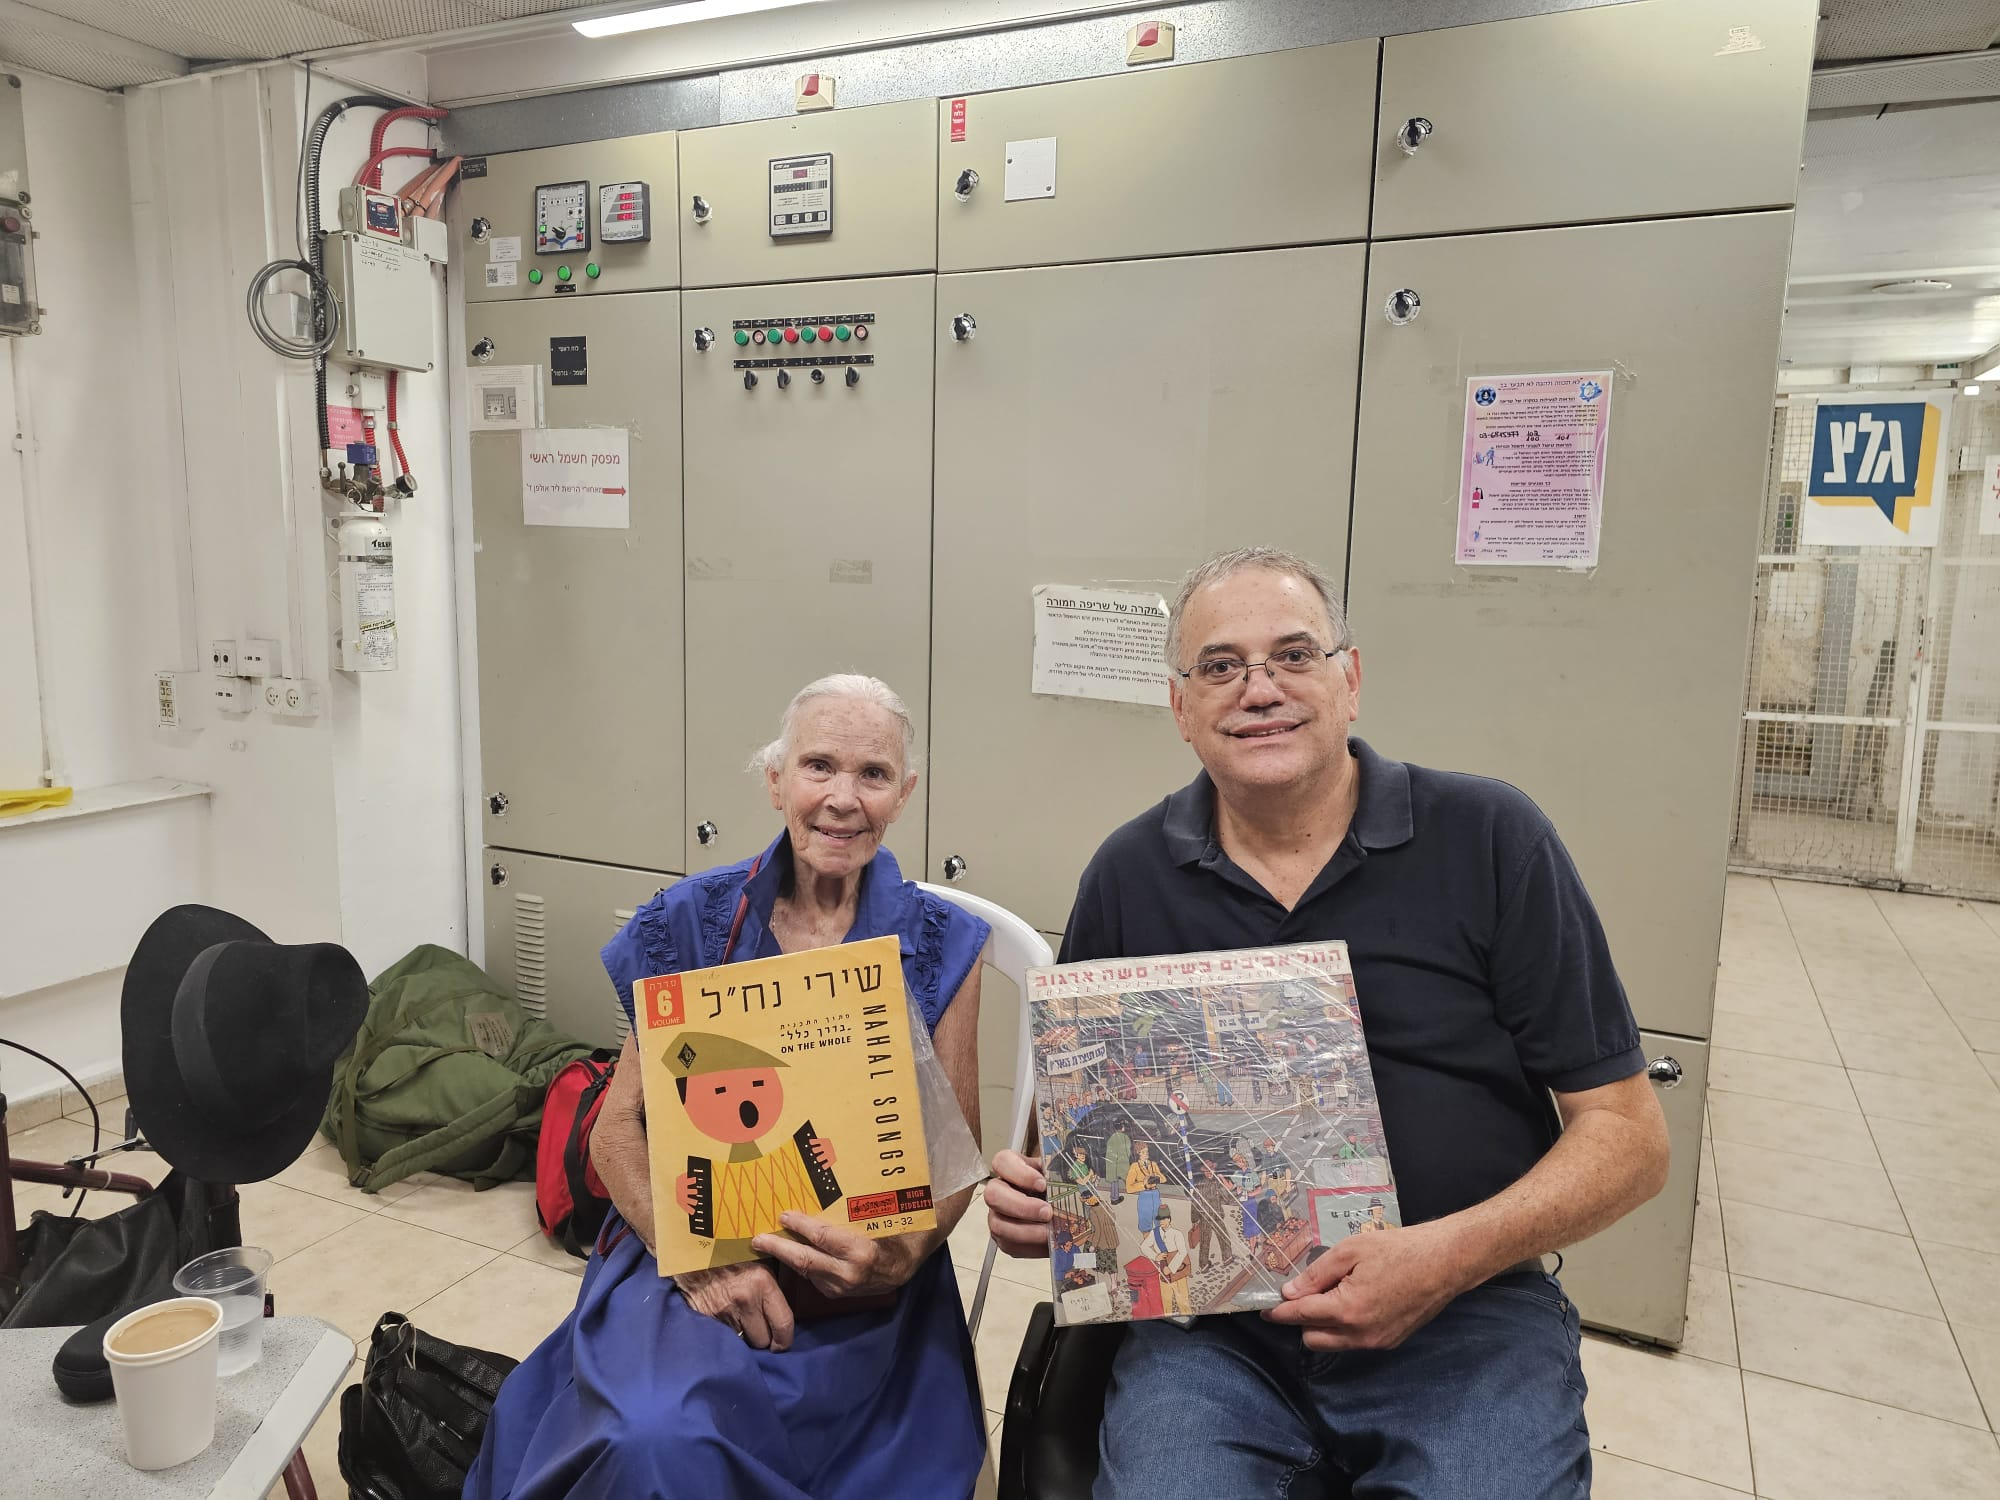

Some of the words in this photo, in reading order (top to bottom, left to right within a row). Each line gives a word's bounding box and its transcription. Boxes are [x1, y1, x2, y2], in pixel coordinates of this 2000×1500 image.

[1823, 412, 1905, 483] גלצ
[530, 452, 554, 464] ראשי
[557, 450, 587, 464] חשמל
[591, 453, 620, 467] מפסק
[551, 483, 560, 493] ליד
[561, 485, 581, 493] הרשת
[1047, 597, 1076, 607] חמורה
[1080, 600, 1110, 610] שריפה
[1114, 601, 1127, 612] של
[804, 964, 881, 998] שירי
[1035, 970, 1094, 988] ארגוב
[649, 980, 677, 991] סדרה
[657, 989, 673, 1017] 6
[701, 981, 783, 1019] נח"ל
[652, 1016, 681, 1027] VOLUME
[780, 1019, 818, 1030] התכנית
[781, 1045, 794, 1054] ON
[797, 1042, 815, 1051] THE
[819, 1036, 852, 1047] WHOLE
[863, 1004, 893, 1079] NAHAL
[873, 1096, 906, 1177] SONGS
[906, 1189, 924, 1199] HIGH
[900, 1199, 932, 1211] FIDELITY
[866, 1222, 879, 1232] AN
